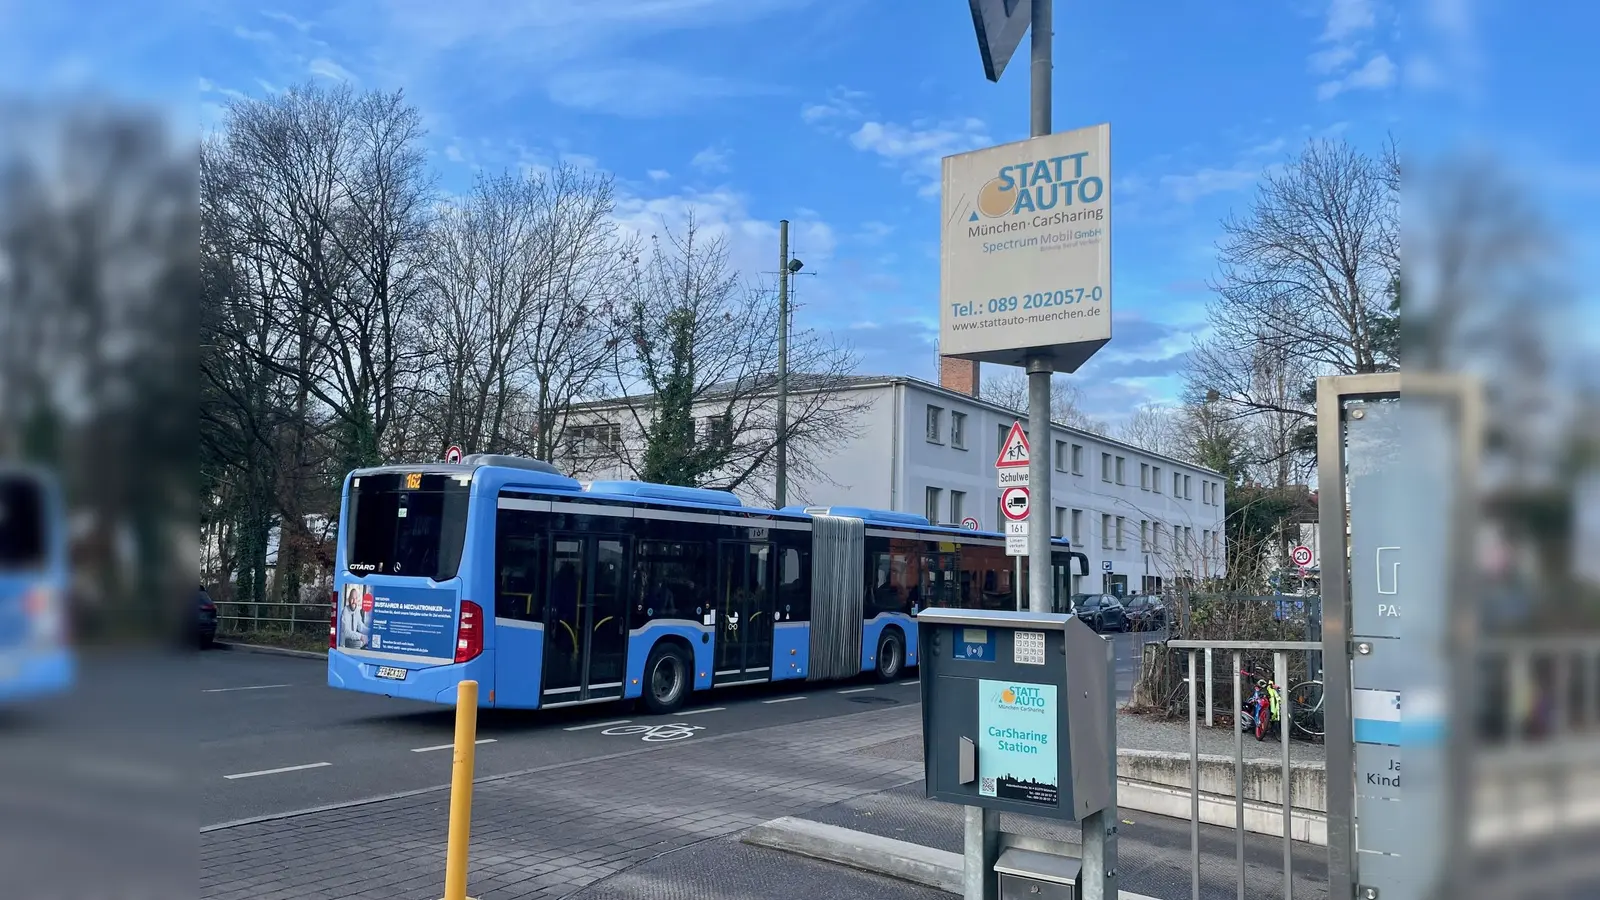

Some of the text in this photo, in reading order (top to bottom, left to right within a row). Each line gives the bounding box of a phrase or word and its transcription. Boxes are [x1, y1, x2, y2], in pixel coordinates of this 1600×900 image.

[998, 152, 1089, 192] STATT
[1012, 176, 1103, 215] AUTO
[982, 228, 1102, 254] Spectrum Mobil GmbH
[952, 286, 1102, 317] Tel.: 089 202057-0
[952, 306, 1100, 331] www.stattauto-muenchen.de
[407, 473, 422, 489] 162
[1296, 552, 1308, 560] 20
[1009, 686, 1040, 698] STATT
[1015, 696, 1045, 707] AUTO
[988, 726, 1047, 744] CarSharing
[998, 740, 1037, 754] Station
[1367, 773, 1400, 787] Kind
